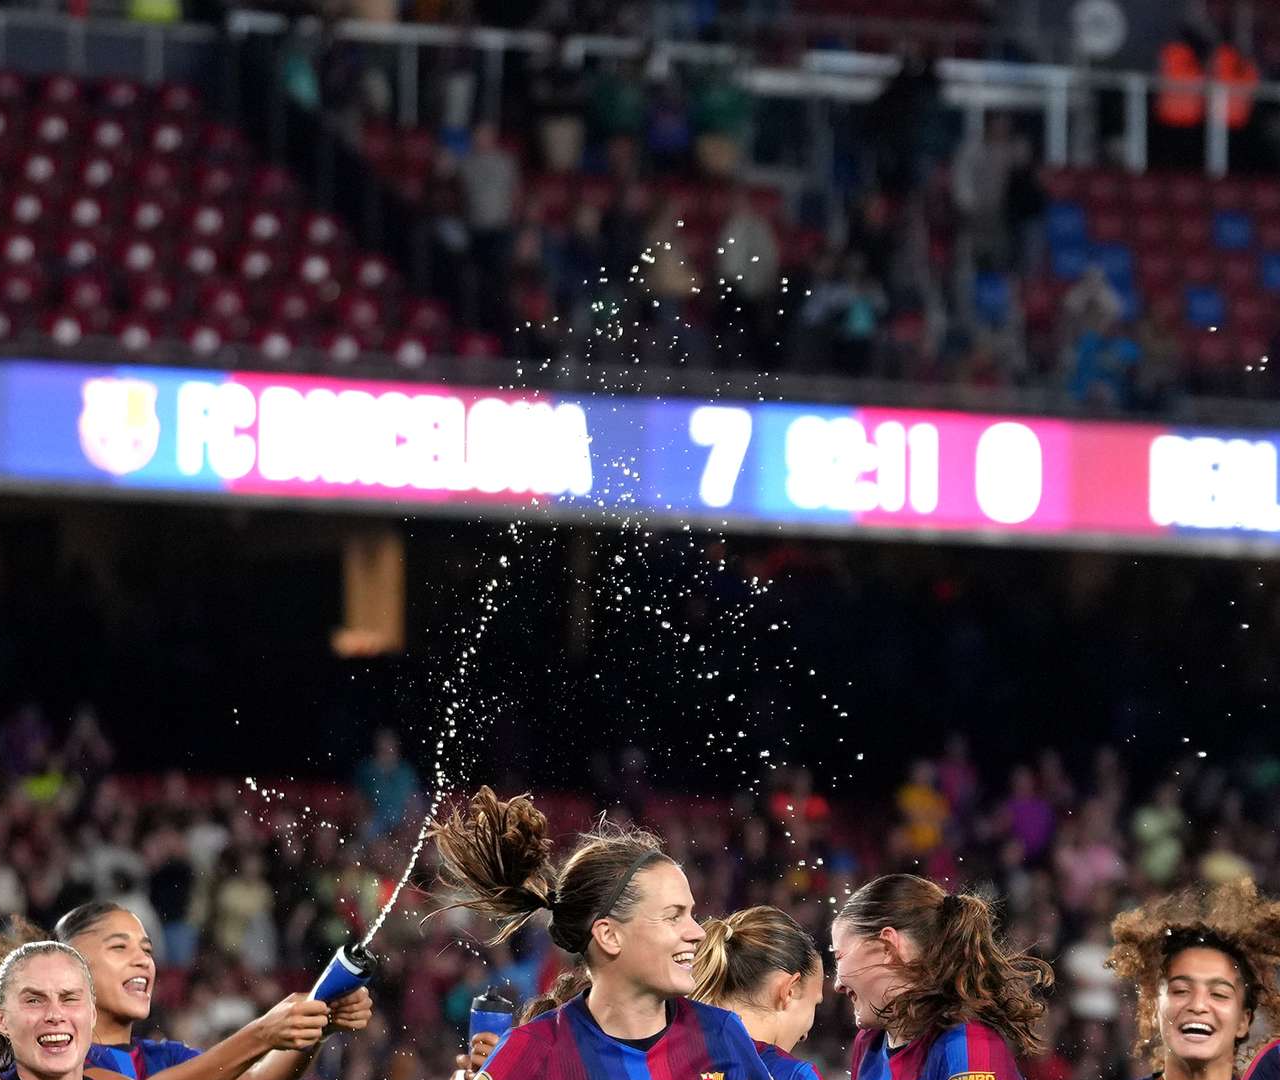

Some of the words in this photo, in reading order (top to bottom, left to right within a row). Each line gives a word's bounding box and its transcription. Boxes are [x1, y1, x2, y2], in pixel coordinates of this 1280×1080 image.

[176, 381, 257, 480] FC
[690, 406, 753, 508] 7
[974, 421, 1044, 524] 0
